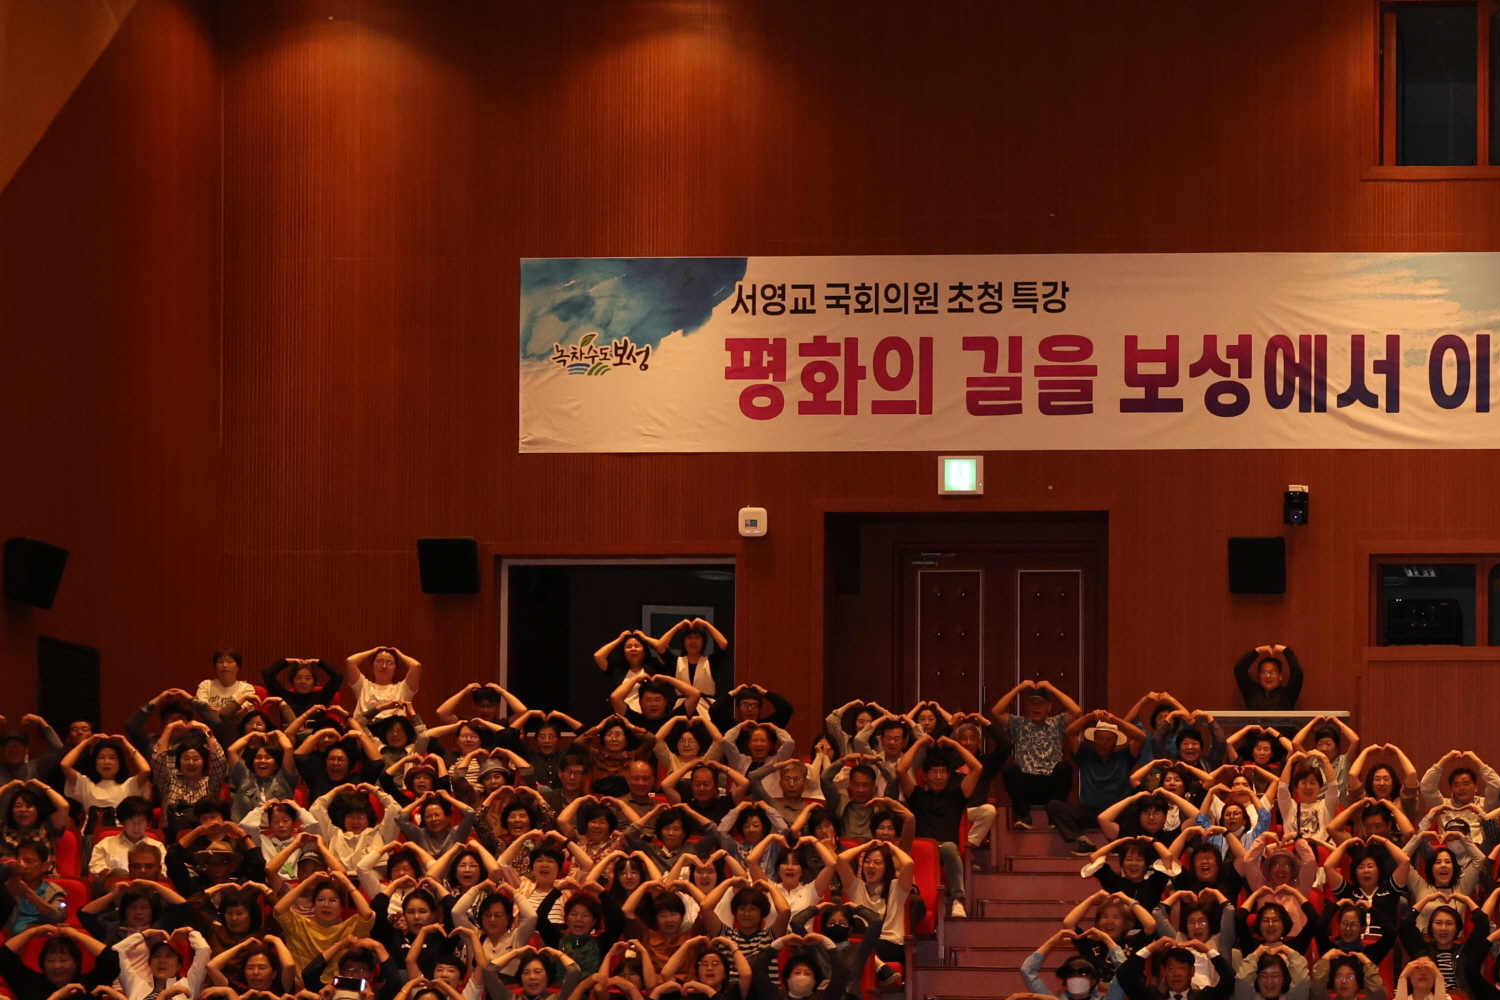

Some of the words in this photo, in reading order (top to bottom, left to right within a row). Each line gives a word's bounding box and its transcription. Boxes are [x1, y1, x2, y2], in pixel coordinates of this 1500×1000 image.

[731, 283, 816, 316] 서영교
[824, 282, 939, 316] 국회의원
[946, 281, 1003, 315] 초청
[1011, 281, 1070, 315] 특강
[724, 335, 934, 420] 평화의
[961, 334, 1098, 417] 길을
[1119, 333, 1400, 418] 보성에서
